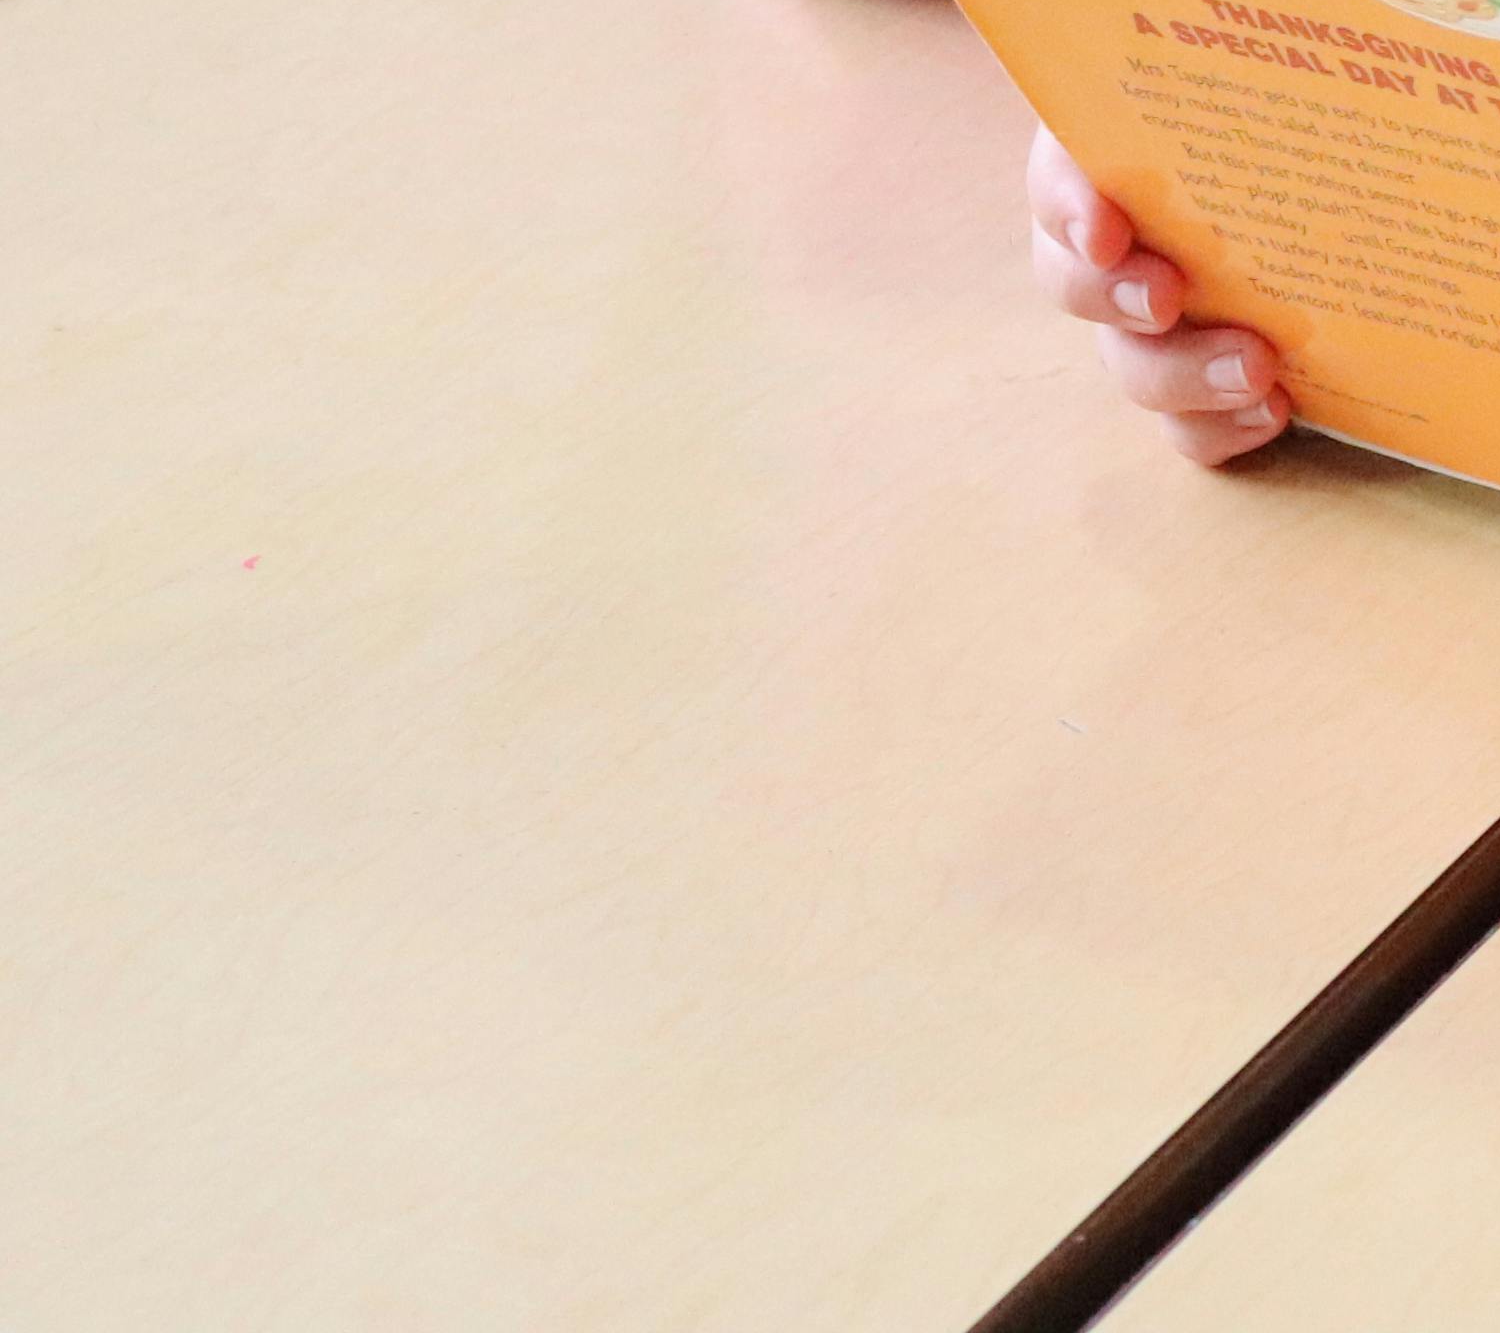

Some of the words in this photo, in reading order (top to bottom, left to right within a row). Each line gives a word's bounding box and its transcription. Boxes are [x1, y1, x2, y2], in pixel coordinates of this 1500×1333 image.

[1130, 14, 1164, 37] A
[1167, 22, 1335, 72] SPECIAL
[1338, 57, 1419, 96] DAY
[1433, 84, 1480, 112] AT
